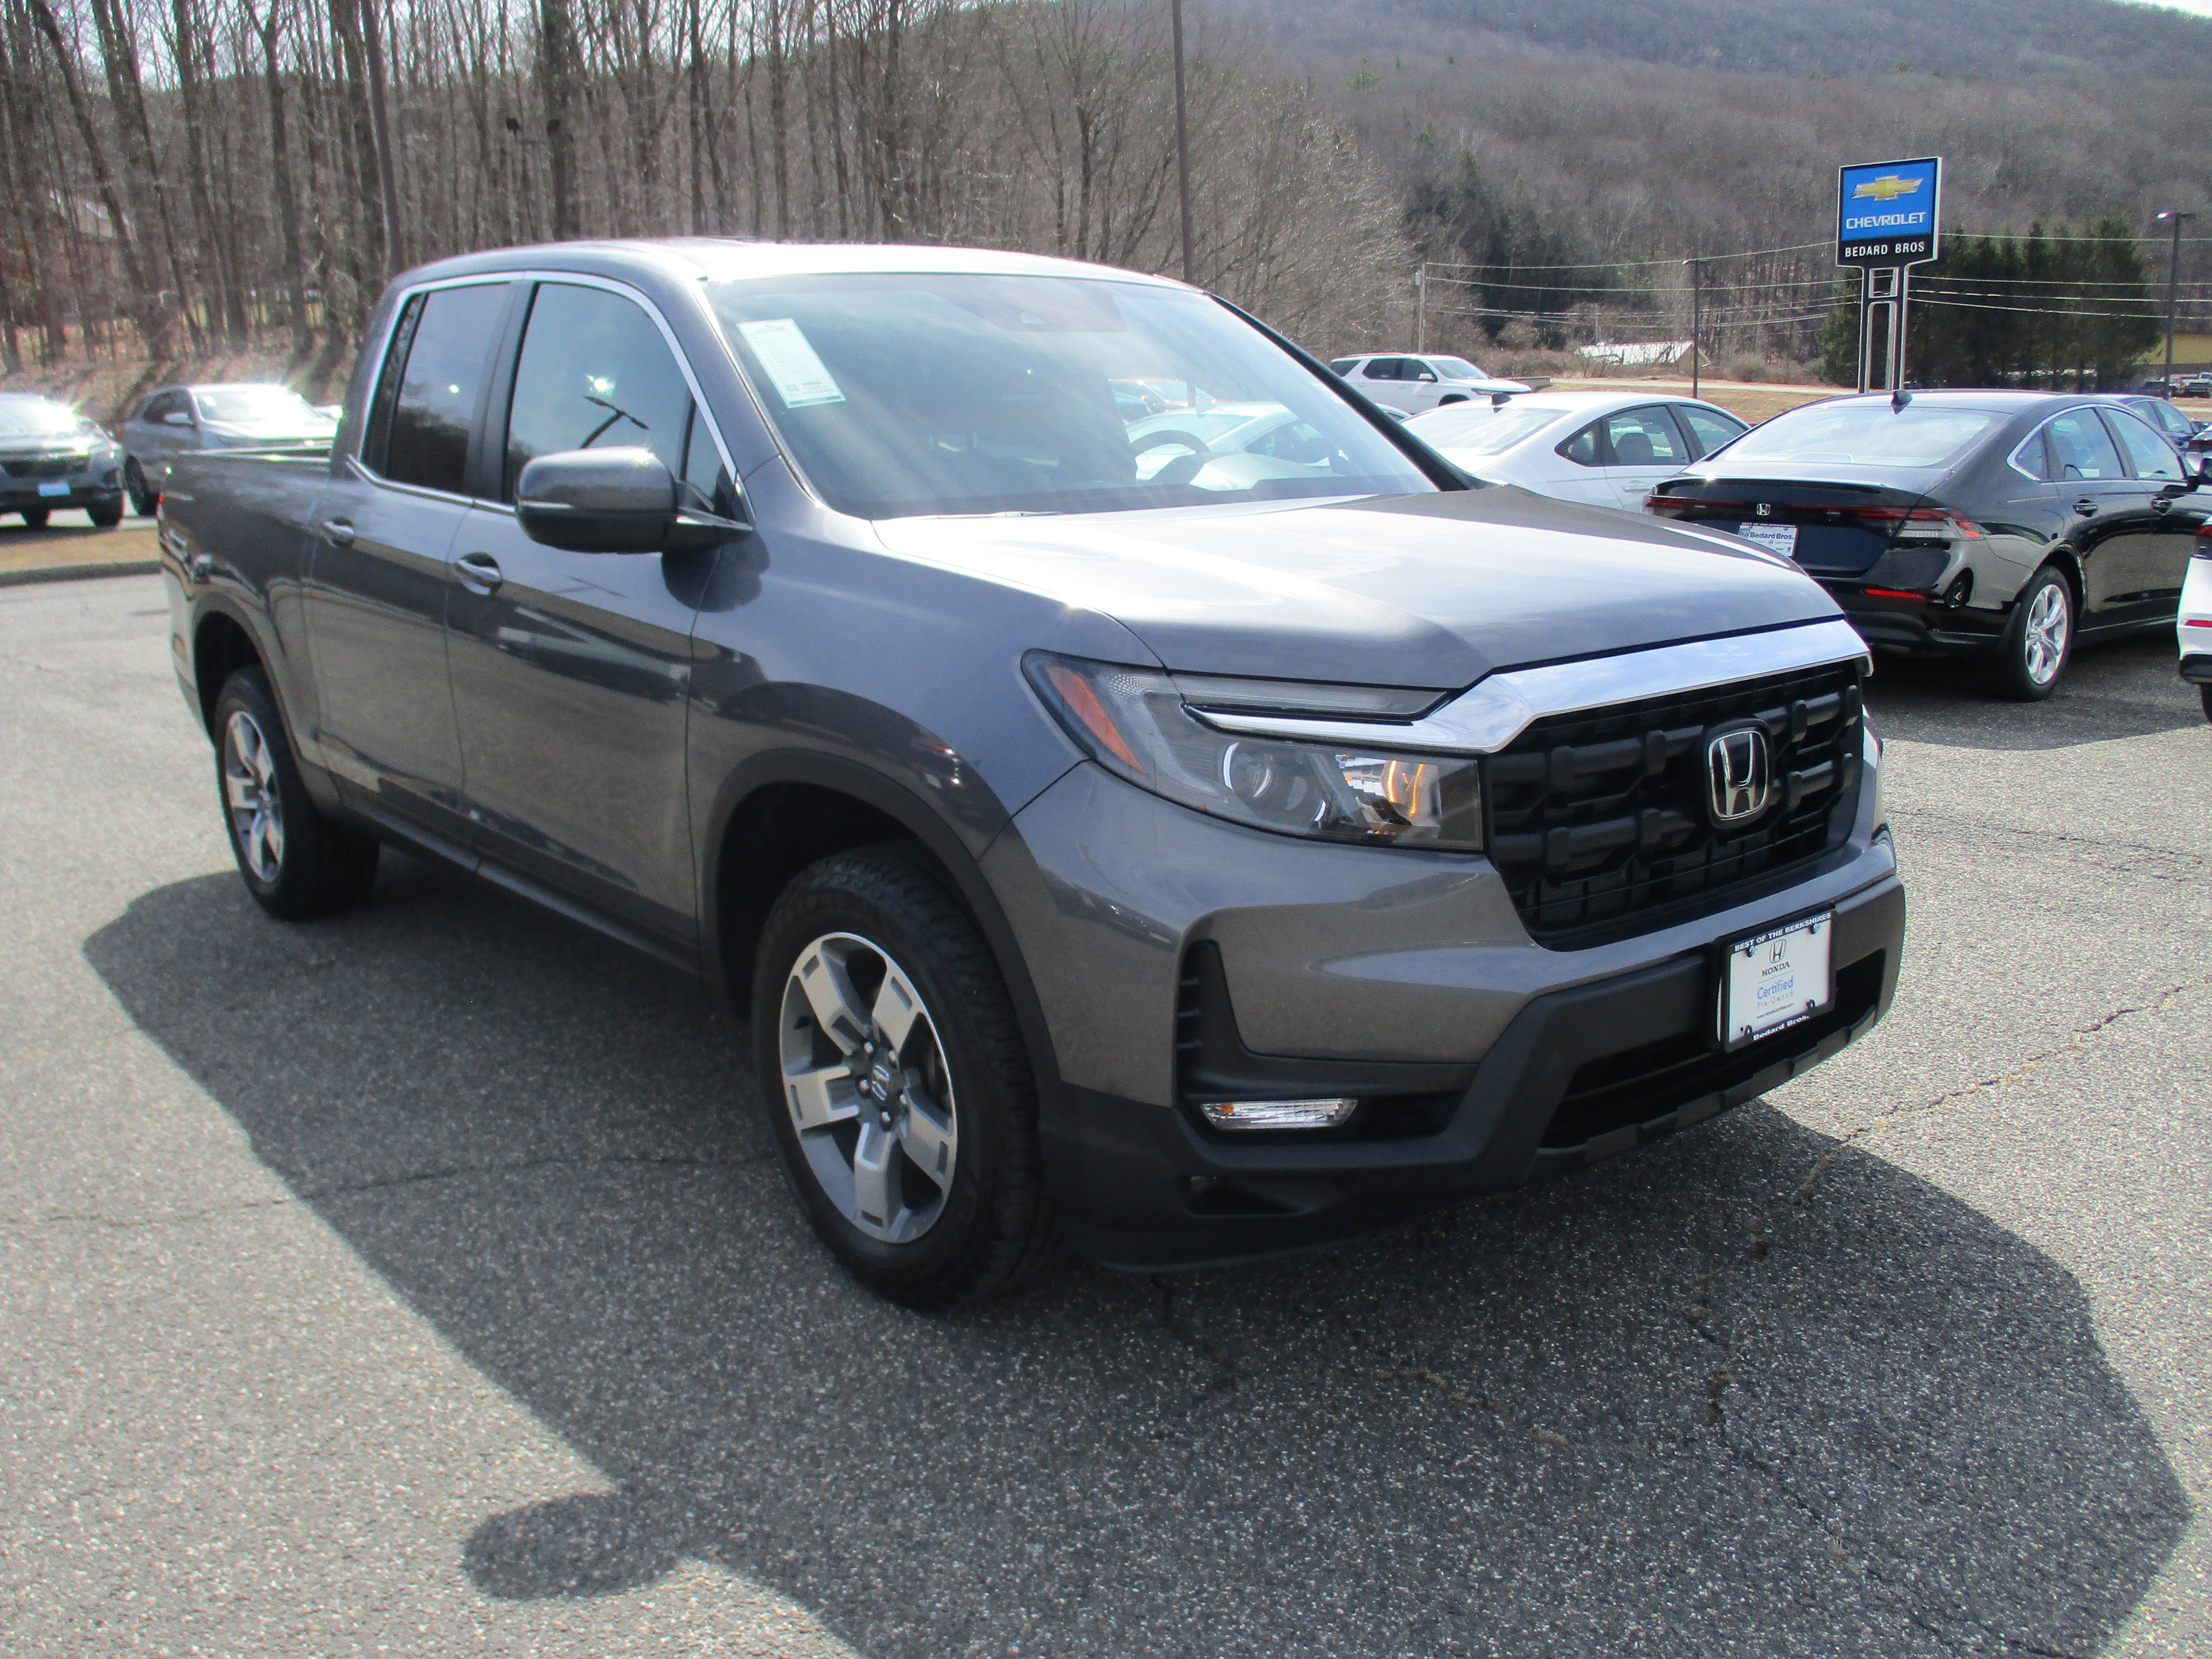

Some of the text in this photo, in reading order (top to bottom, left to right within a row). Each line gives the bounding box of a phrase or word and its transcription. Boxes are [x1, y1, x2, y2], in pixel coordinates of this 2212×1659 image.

[1846, 212, 1926, 229] CHEVROLET
[1845, 241, 1925, 258] BEDARD BROS
[1735, 939, 1756, 951] BEST
[1768, 928, 1784, 939] THE
[1785, 912, 1831, 933] BERKSHIRES
[1762, 962, 1790, 976] HONDA
[1757, 975, 1793, 999] Certified
[1757, 989, 1793, 1009] Pre-Owned
[1753, 1023, 1784, 1041] Bedard
